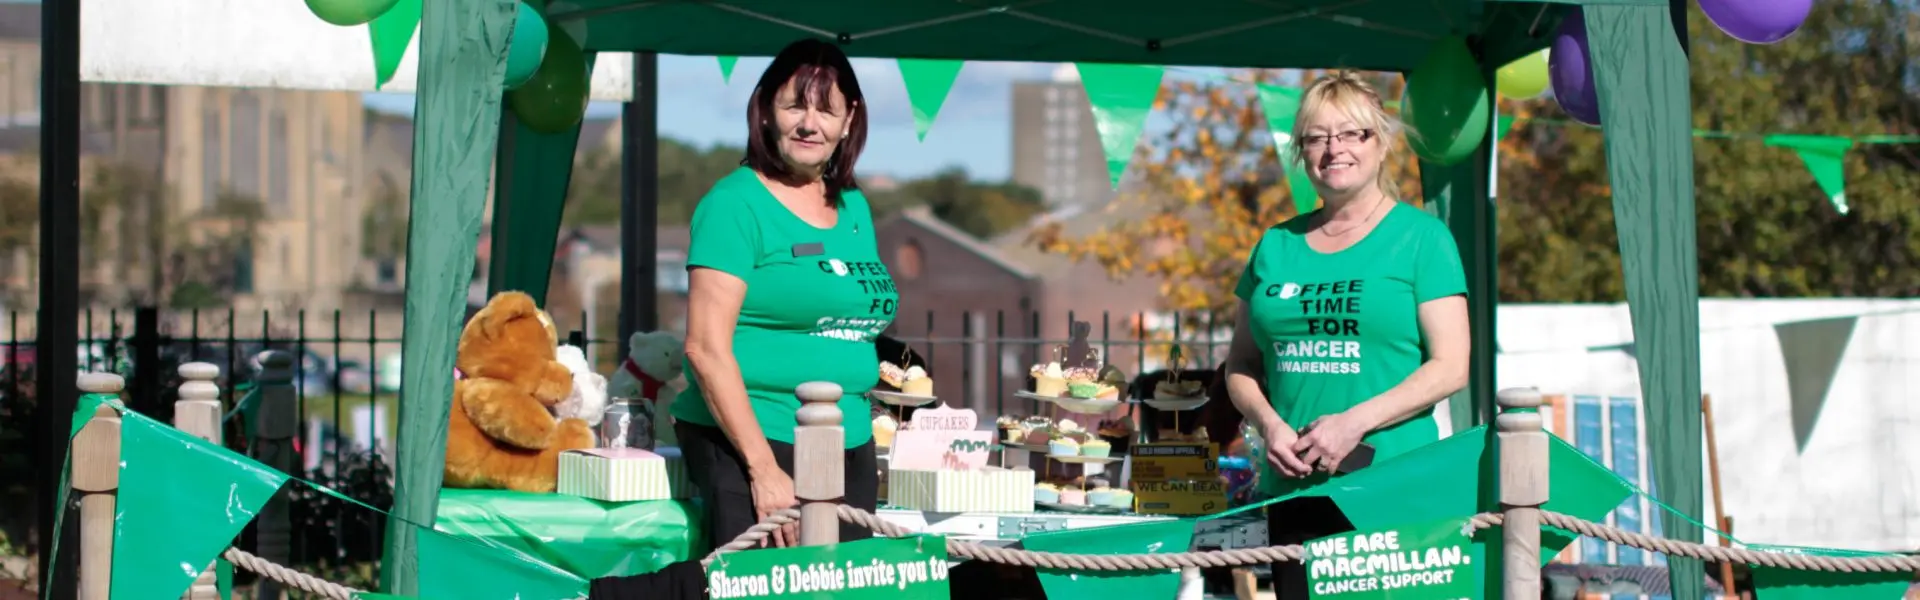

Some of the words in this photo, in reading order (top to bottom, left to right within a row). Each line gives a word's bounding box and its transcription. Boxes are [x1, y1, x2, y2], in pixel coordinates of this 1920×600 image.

[1266, 279, 1364, 299] COFFEE
[1299, 296, 1360, 315] TIME
[1308, 319, 1360, 336] FOR
[1273, 341, 1361, 358] CANCER
[1276, 361, 1361, 374] AWARENESS
[920, 416, 969, 431] CUPCAKES
[1139, 481, 1160, 492] WE
[1161, 481, 1188, 492] CAN
[1311, 537, 1349, 557] WE
[1353, 531, 1400, 553] ARE
[1311, 545, 1471, 579] MACMILLAN.
[710, 570, 769, 599] Sharon
[772, 565, 786, 594] &
[788, 563, 844, 594] Debbie
[847, 559, 895, 588] invite
[897, 560, 927, 589] you
[929, 555, 947, 580] to
[1314, 577, 1378, 595] CANCER
[1382, 569, 1454, 589] SUPPORT
